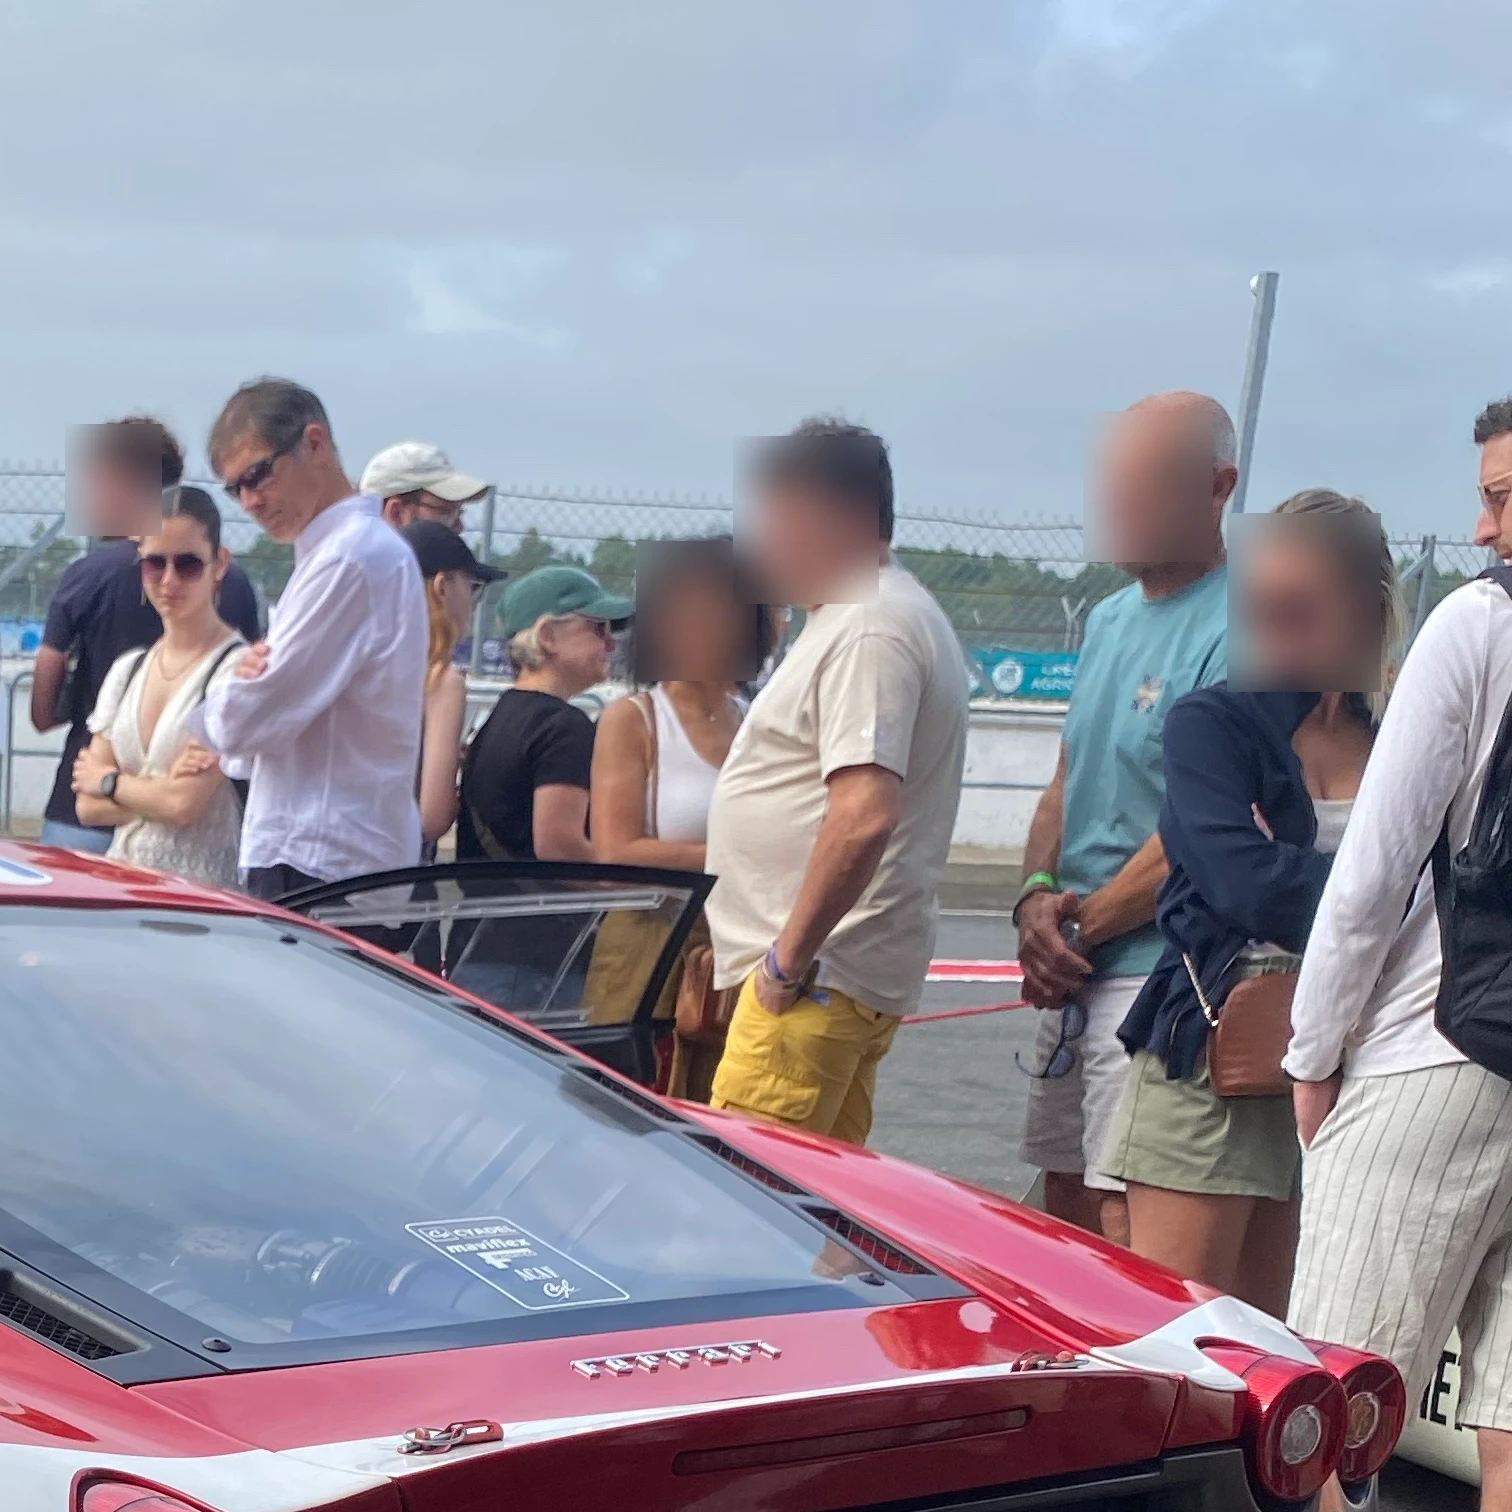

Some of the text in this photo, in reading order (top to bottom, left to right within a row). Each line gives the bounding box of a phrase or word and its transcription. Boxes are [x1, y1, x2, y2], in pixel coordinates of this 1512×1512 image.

[454, 1224, 517, 1238] CYADEL
[446, 1238, 532, 1254] maviflex
[569, 1339, 783, 1381] Ferrari
